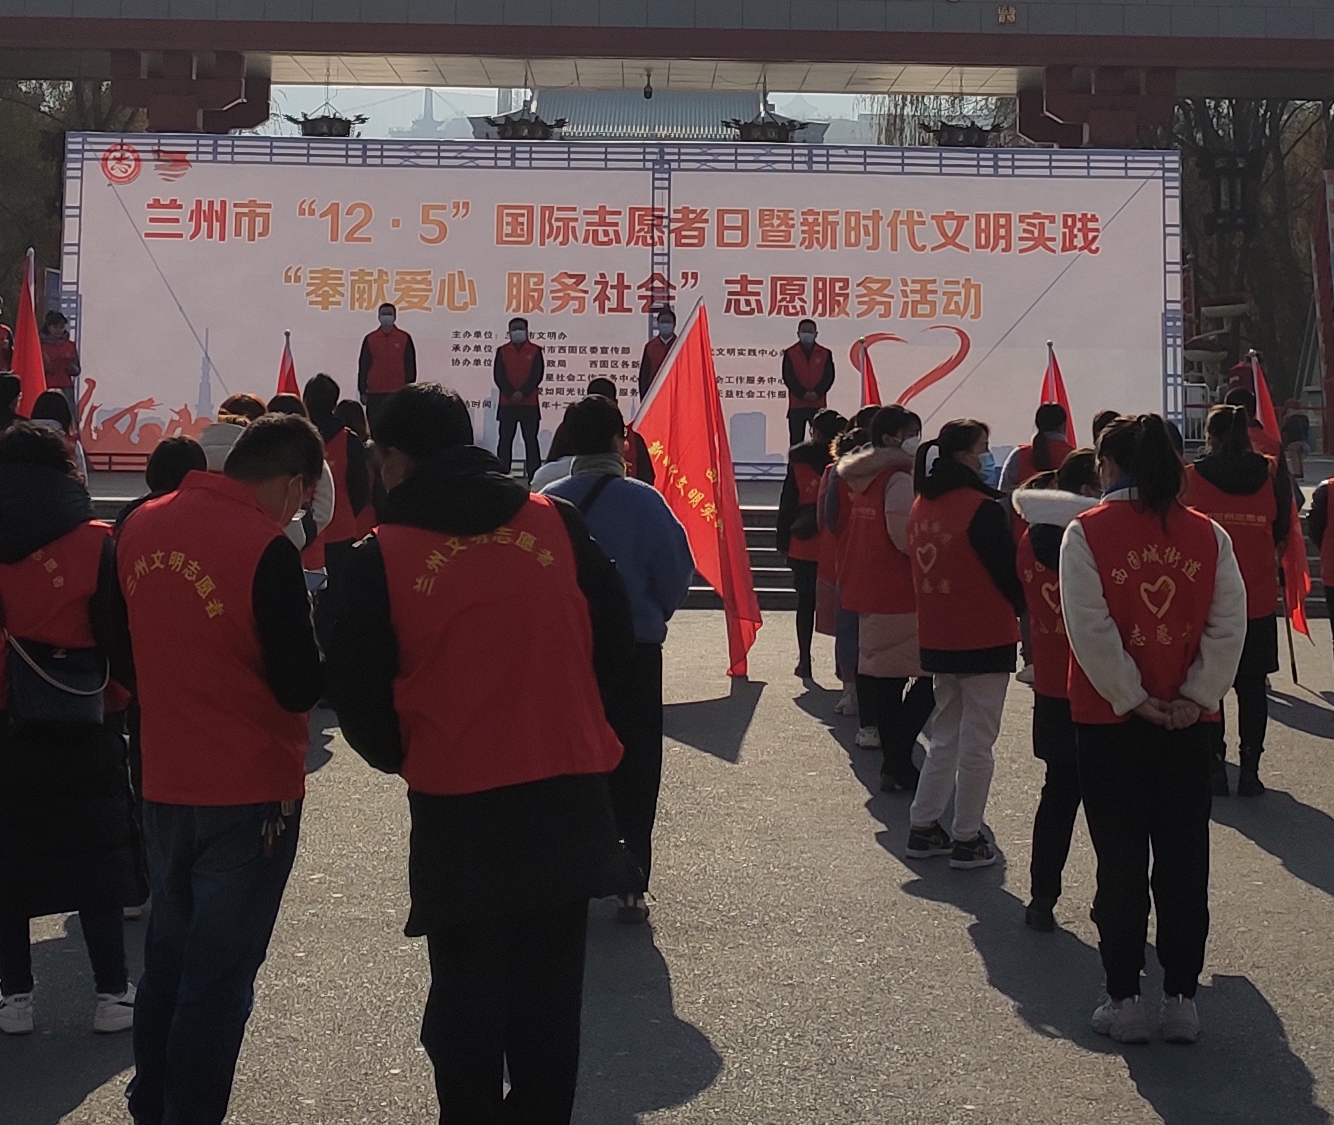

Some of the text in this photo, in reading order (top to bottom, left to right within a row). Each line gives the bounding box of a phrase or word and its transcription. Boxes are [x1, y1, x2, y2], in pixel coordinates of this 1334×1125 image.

[126, 549, 225, 619] 兰州文明志愿者
